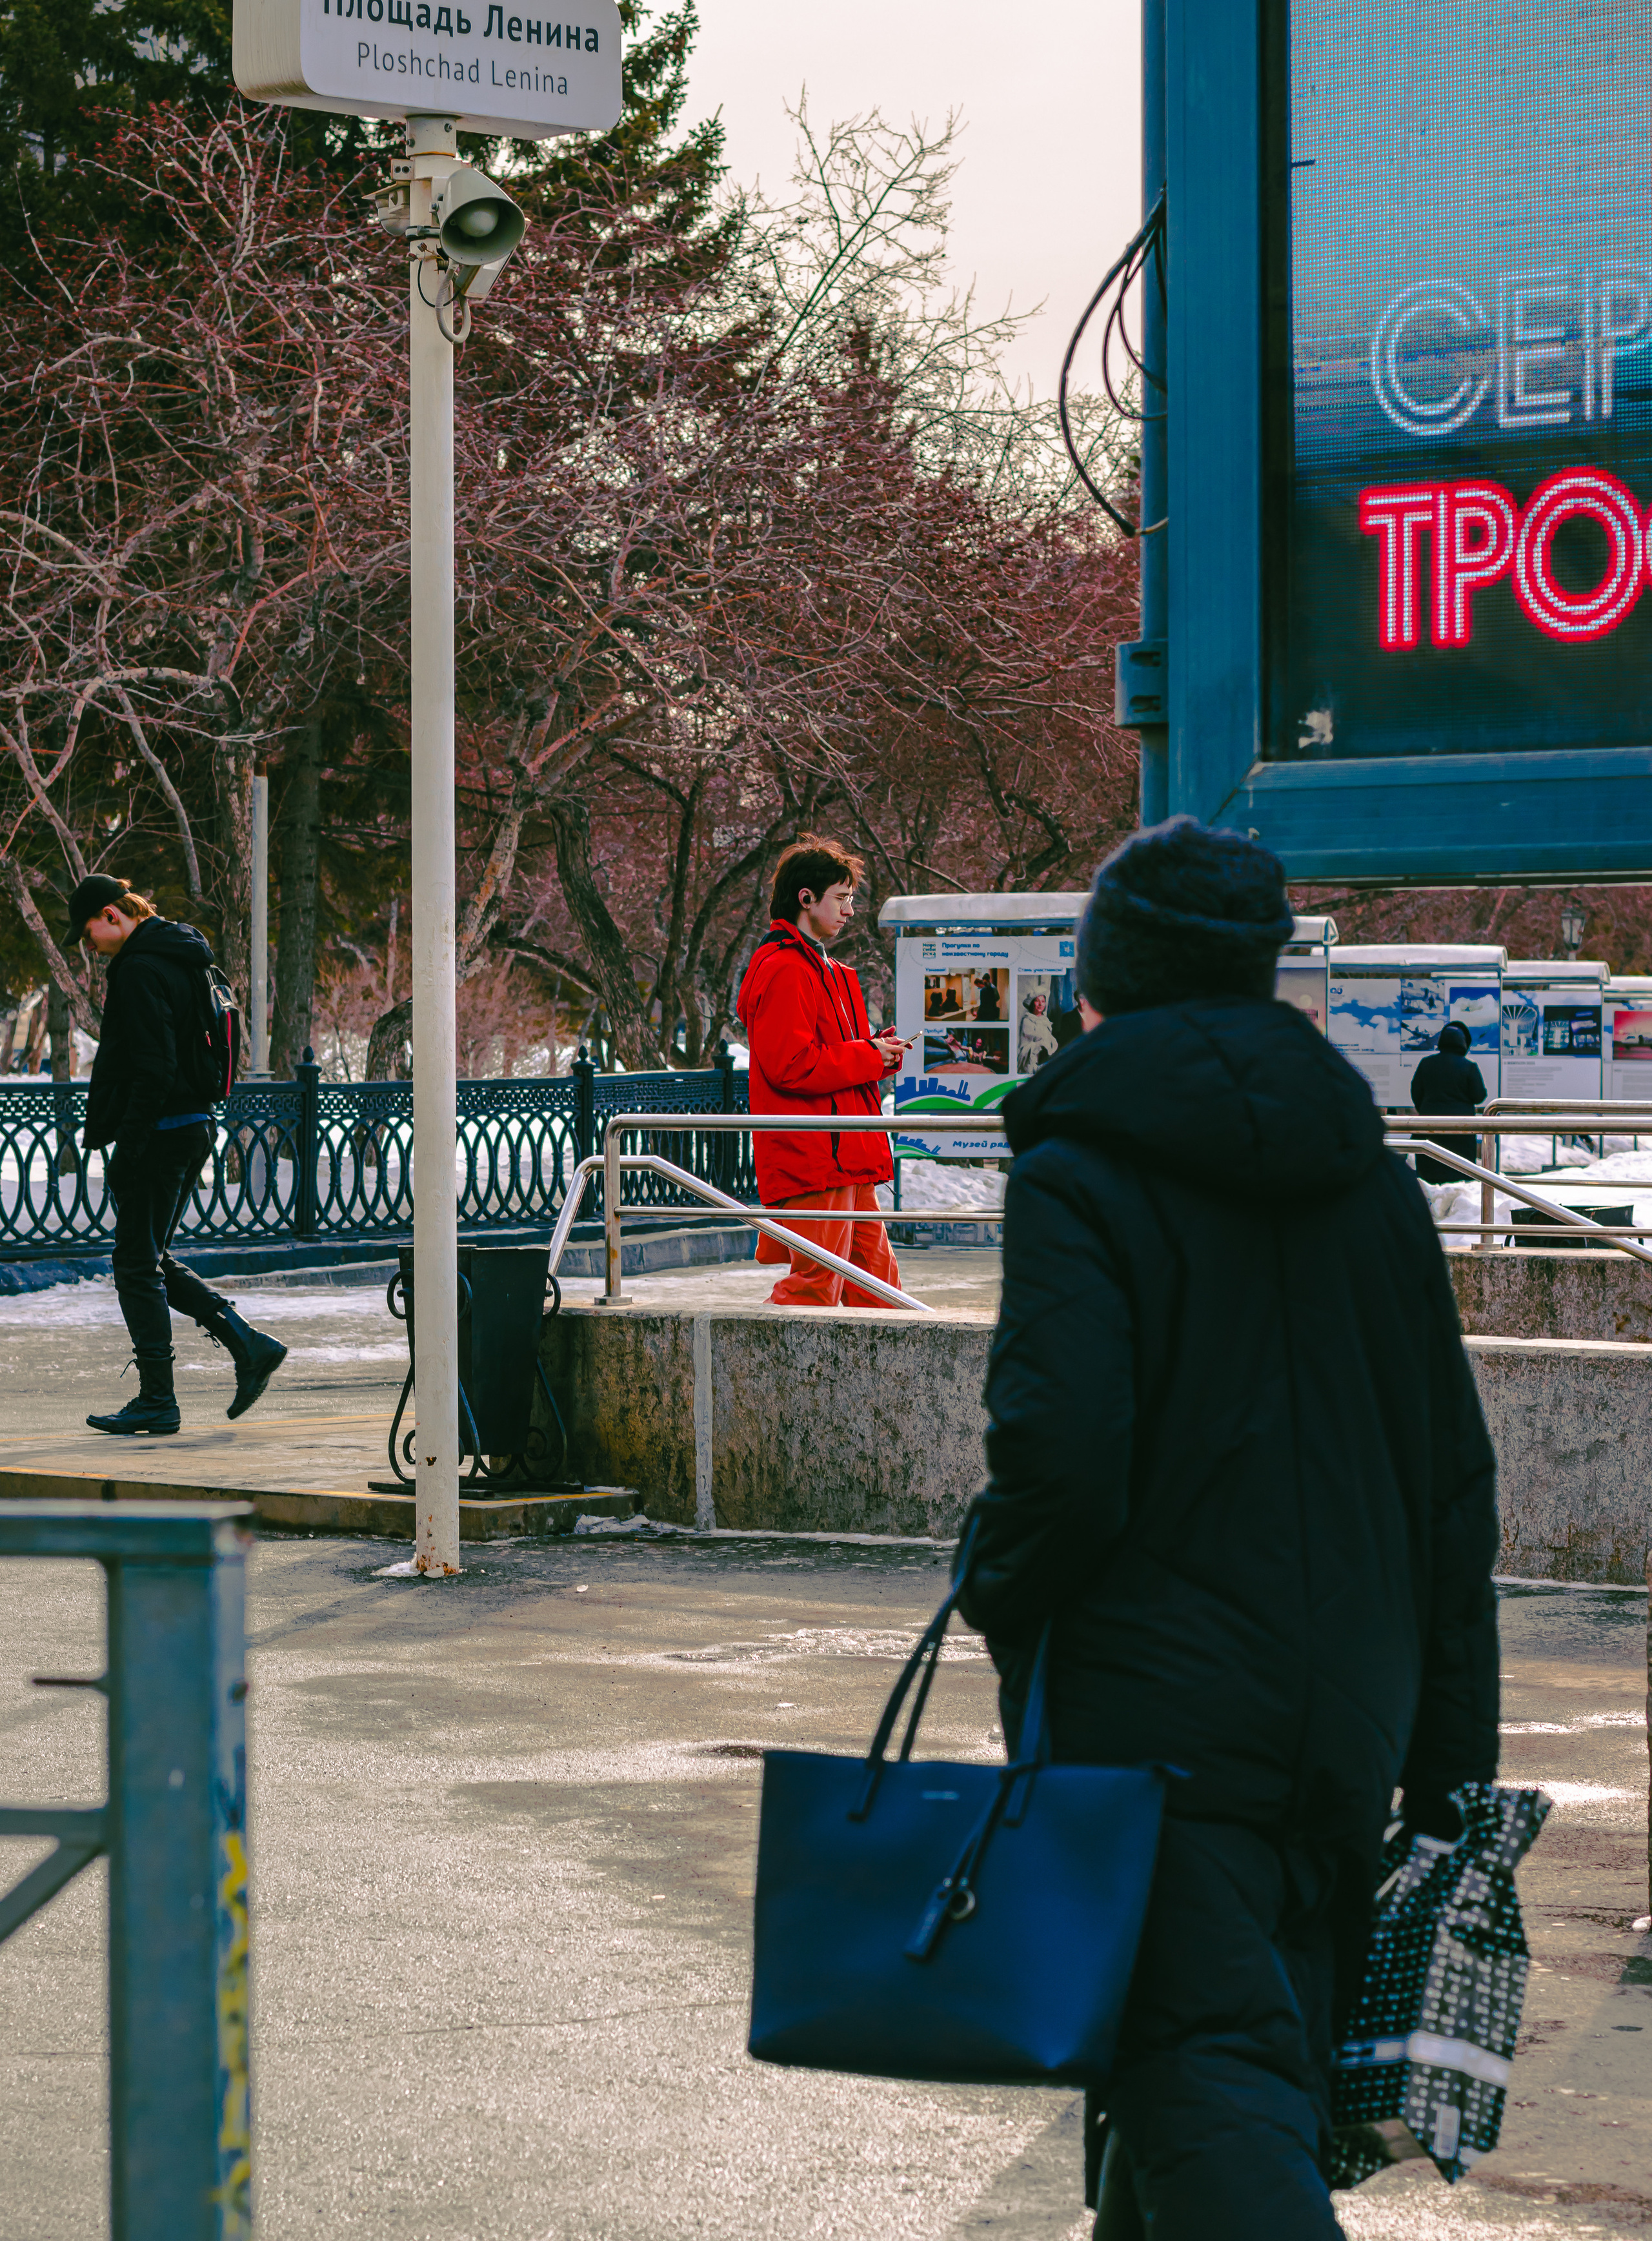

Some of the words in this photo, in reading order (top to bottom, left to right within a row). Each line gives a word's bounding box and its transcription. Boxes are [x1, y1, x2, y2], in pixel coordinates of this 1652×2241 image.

[483, 4, 599, 53] Ленина
[358, 41, 479, 84] Ploshchad
[492, 60, 568, 95] Lenina
[1358, 466, 1652, 651] ТРО
[952, 1141, 988, 1149] Музей
